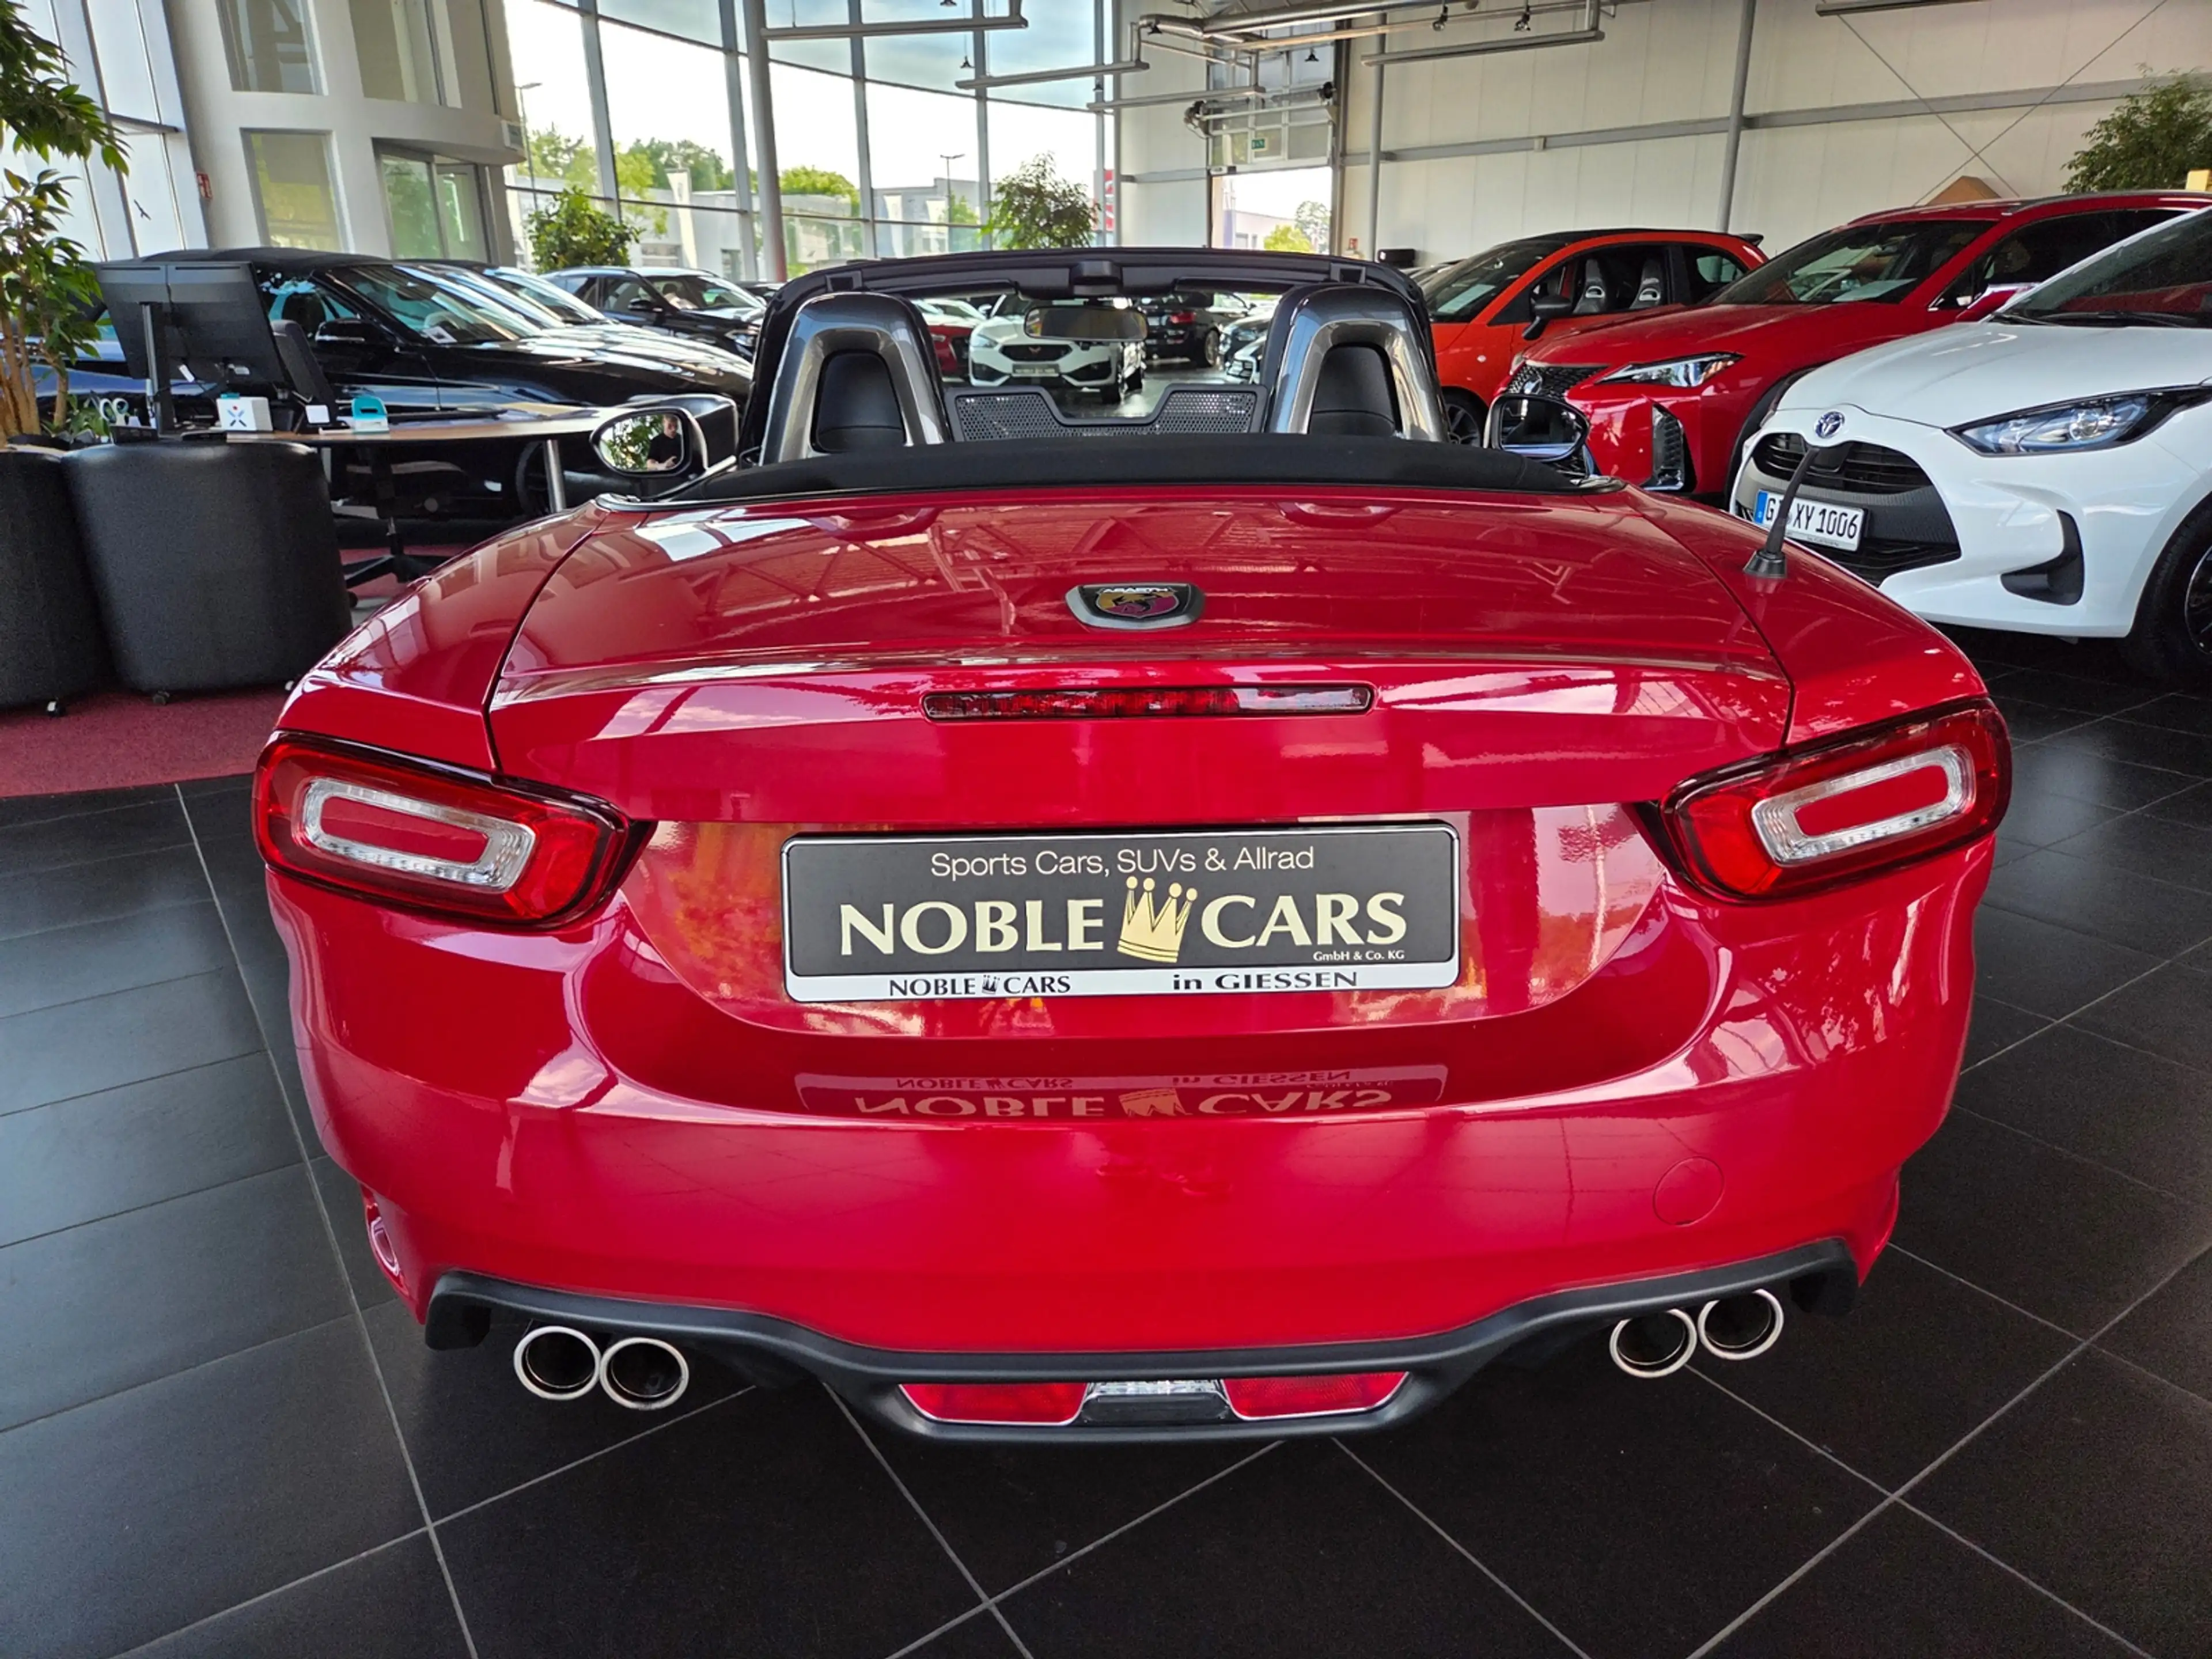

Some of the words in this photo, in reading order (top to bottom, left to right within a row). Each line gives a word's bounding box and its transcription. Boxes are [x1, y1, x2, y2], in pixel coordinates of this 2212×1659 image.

[1766, 498, 1783, 521] G
[1793, 503, 1815, 530] XY
[1816, 509, 1858, 539] 1006
[931, 853, 1027, 882] Sports
[1035, 850, 1110, 877] Cars,
[1117, 849, 1196, 873] SUVs
[1205, 847, 1227, 872] &
[1233, 846, 1314, 870] Allrad
[840, 898, 1104, 955] NOBLE
[1200, 892, 1407, 948] CARS
[1313, 951, 1350, 961] GmbH
[1353, 952, 1362, 961] &
[1365, 950, 1385, 961] Co.
[1388, 950, 1405, 960] KG
[889, 978, 976, 996] NOBLE
[1003, 975, 1071, 994] CARS
[1173, 974, 1202, 990] in
[1215, 971, 1357, 990] GIESSEN
